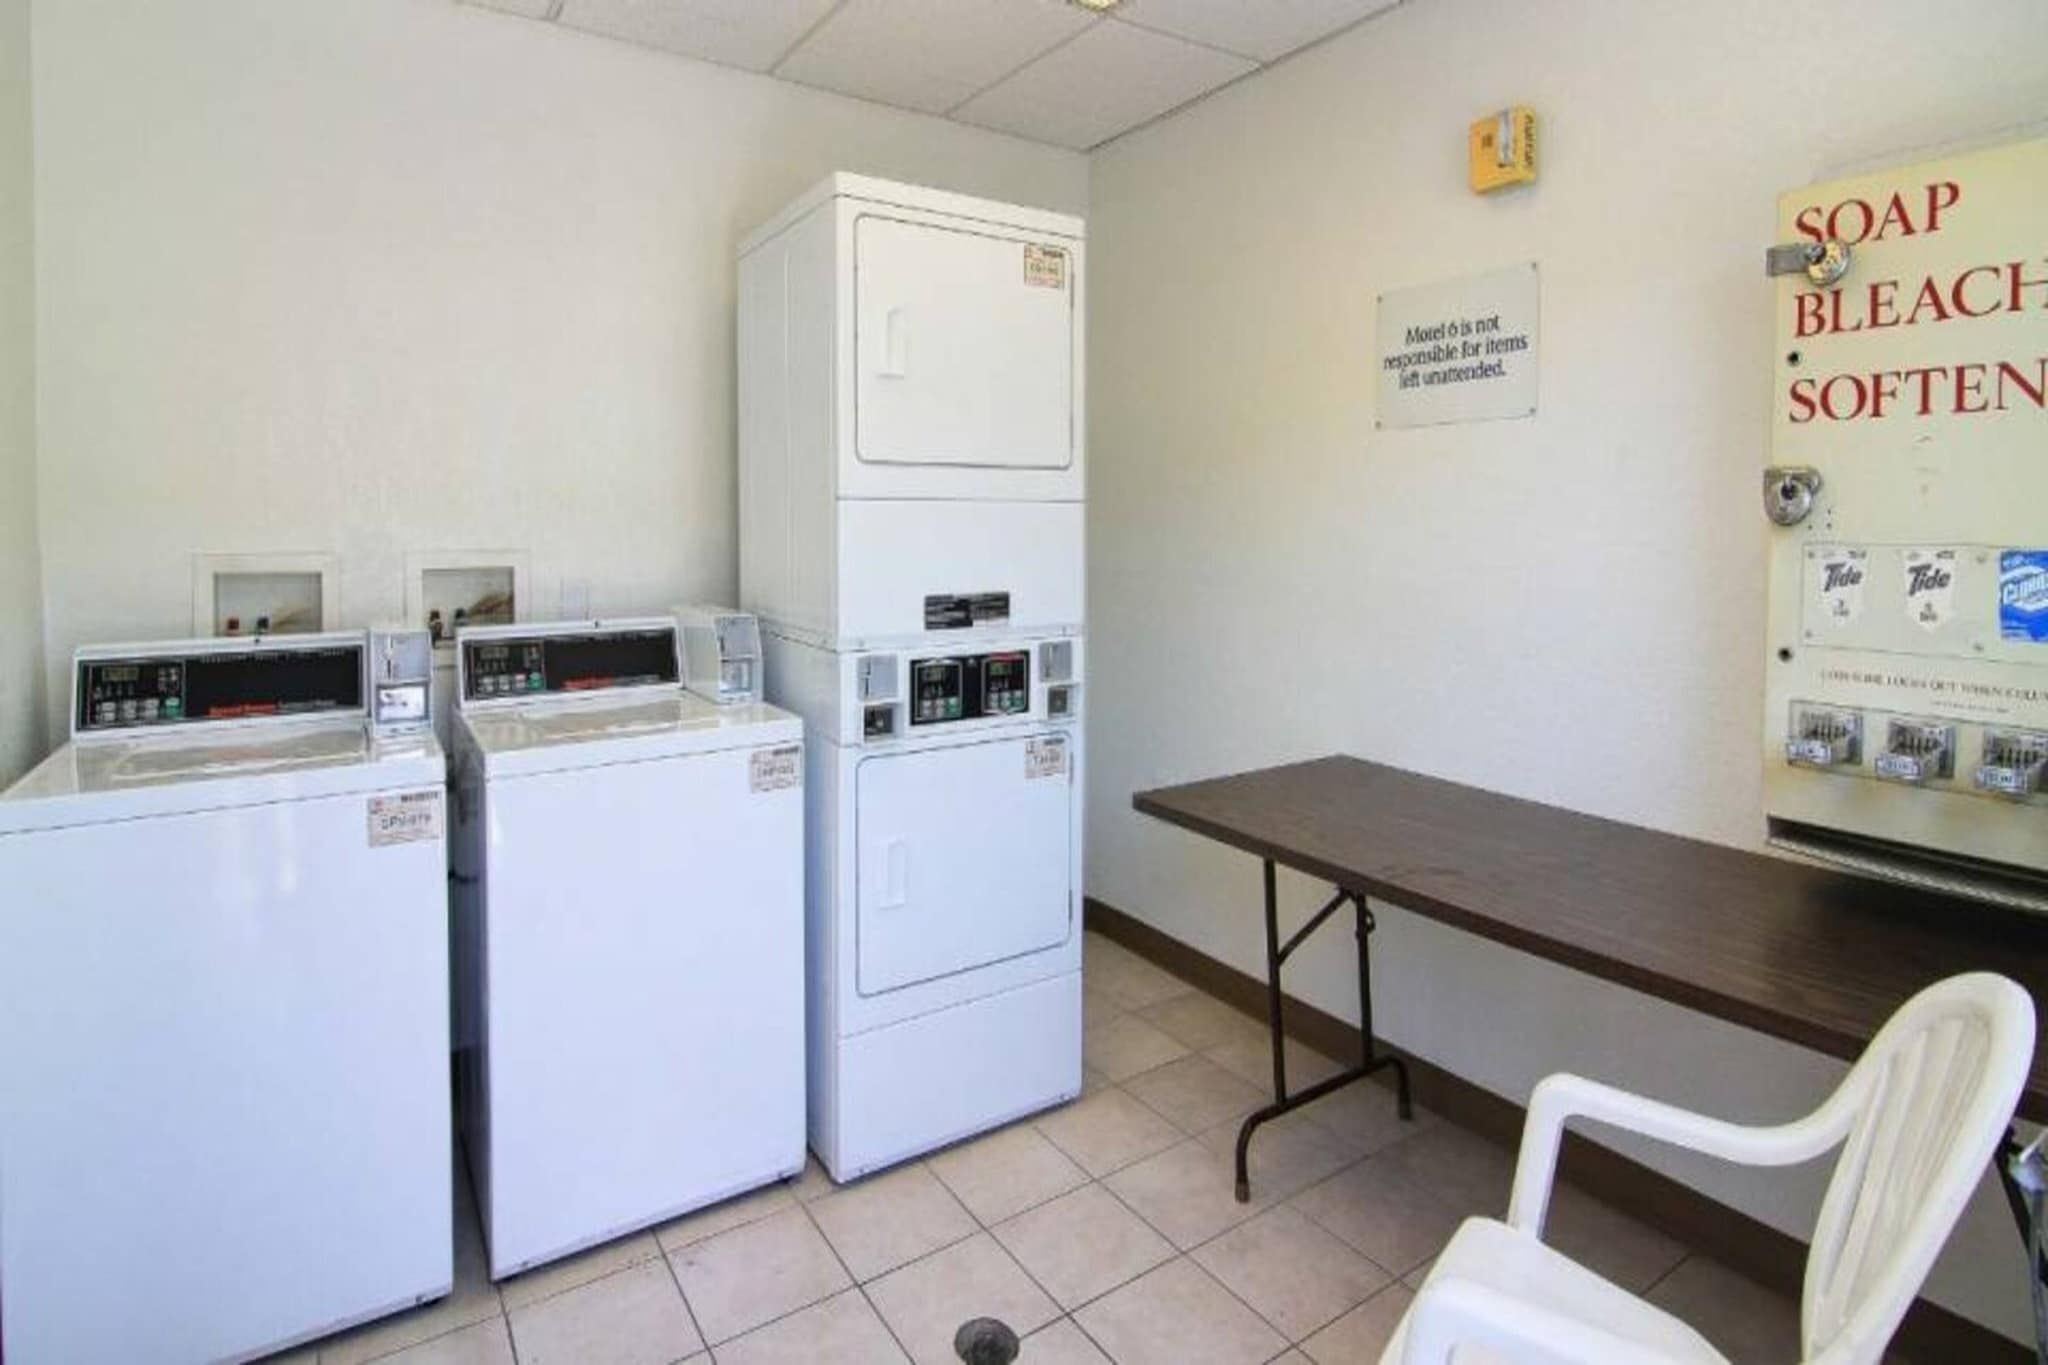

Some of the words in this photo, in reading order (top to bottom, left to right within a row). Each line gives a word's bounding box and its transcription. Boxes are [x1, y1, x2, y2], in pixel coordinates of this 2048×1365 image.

[1795, 181, 1960, 247] SOAP
[1794, 257, 2048, 338] BLEACH
[1404, 323, 1446, 345] Motel
[1447, 321, 1459, 338] 6
[1460, 317, 1473, 337] is
[1475, 314, 1500, 334] not
[1383, 344, 1459, 373] responsible
[1461, 340, 1482, 360] for
[1485, 335, 1528, 355] items
[1399, 368, 1421, 390] left
[1823, 563, 1863, 592] Tide
[1907, 563, 1952, 597] Tide
